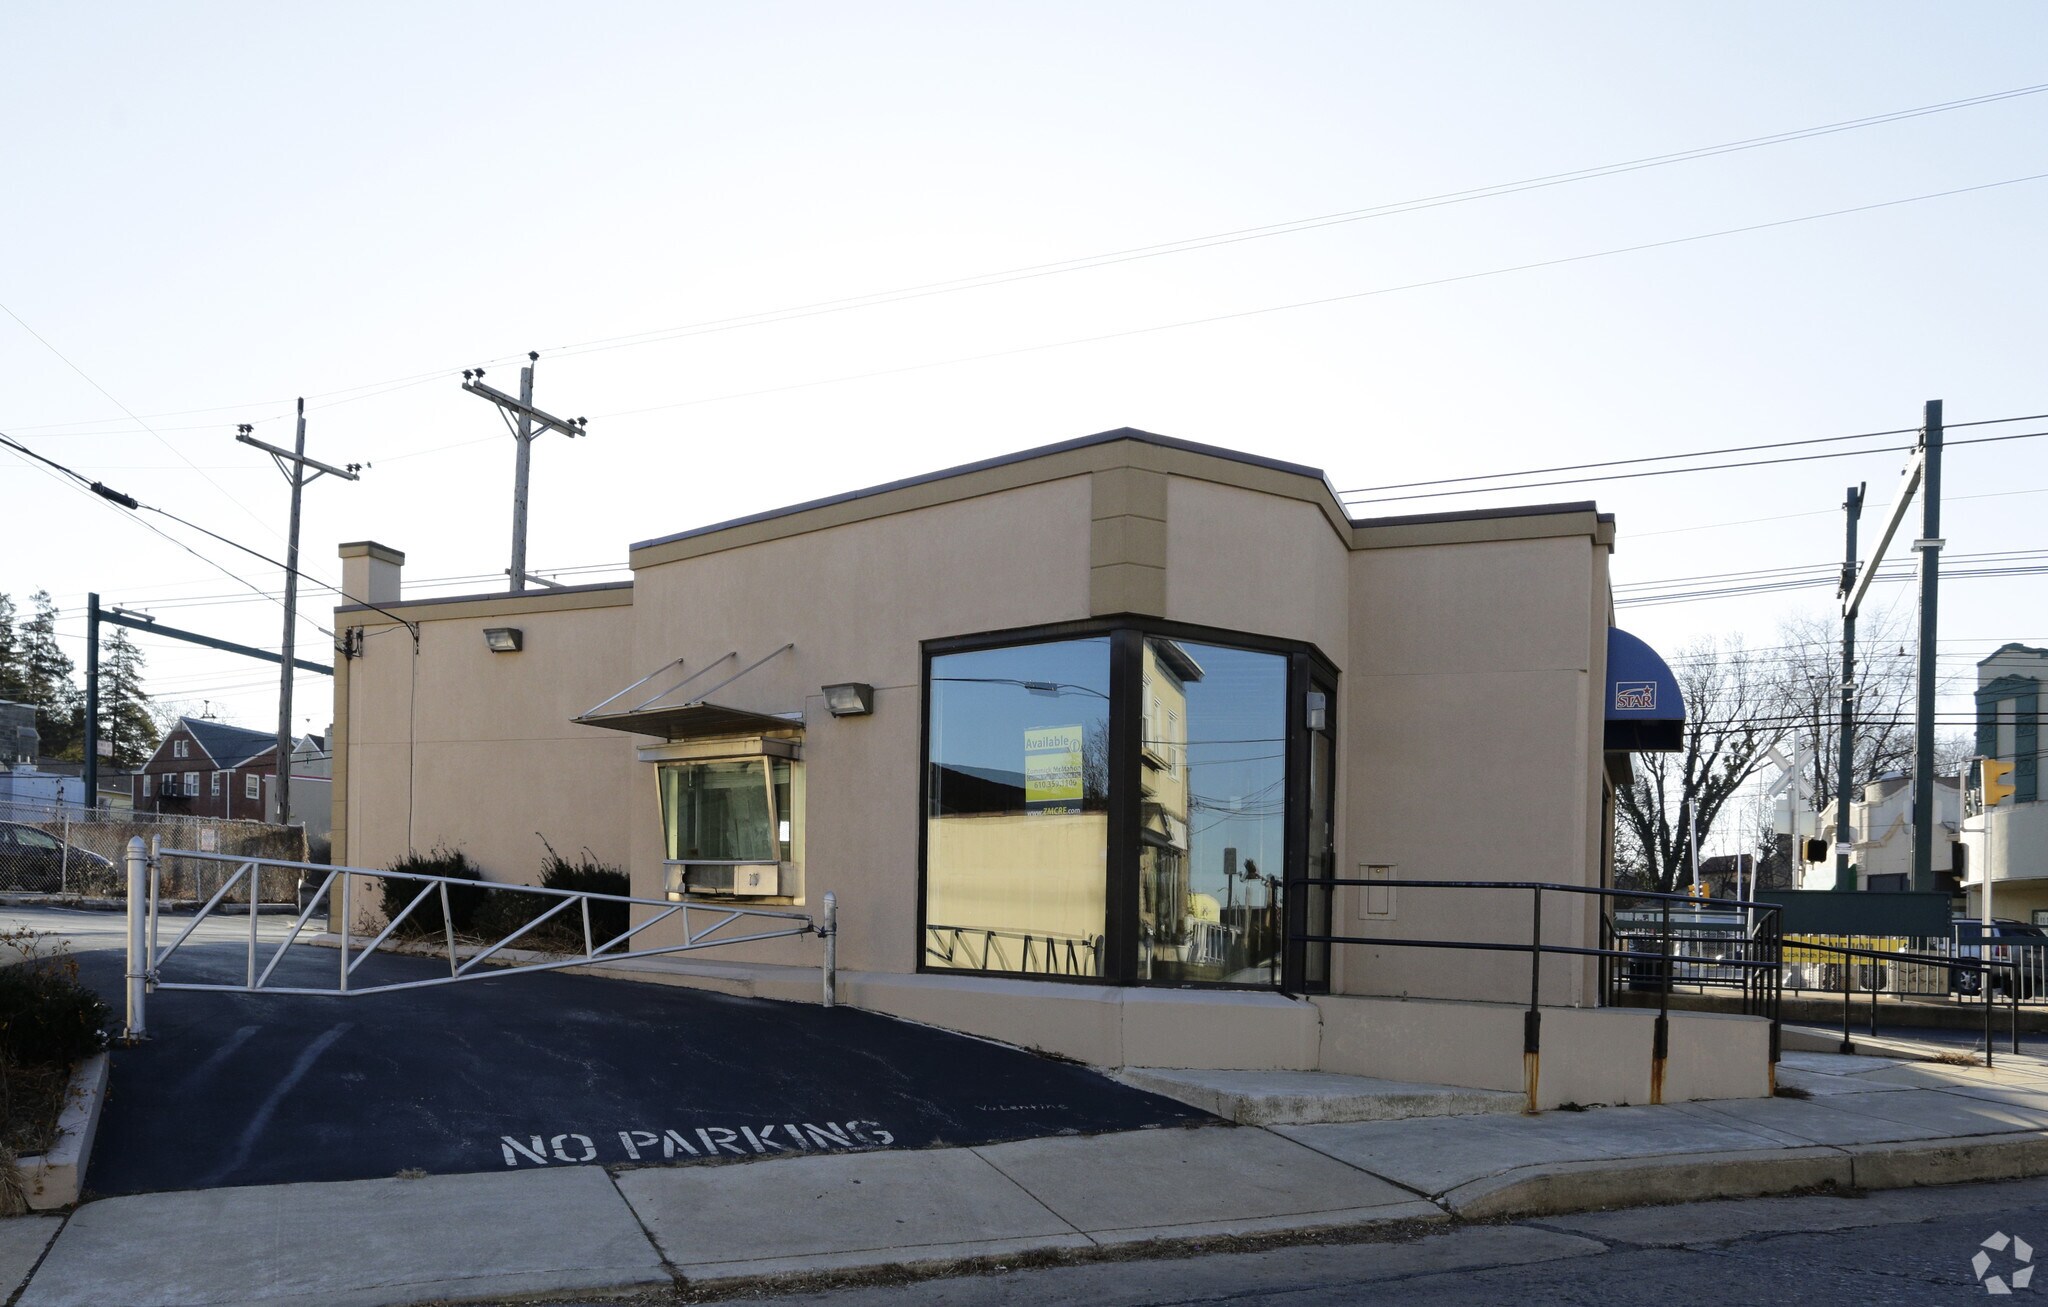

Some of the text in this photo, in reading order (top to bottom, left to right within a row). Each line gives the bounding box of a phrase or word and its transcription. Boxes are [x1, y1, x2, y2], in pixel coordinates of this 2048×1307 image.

[1617, 695, 1654, 707] STAR
[1026, 735, 1069, 749] Available
[1053, 765, 1081, 773] McMahon
[500, 1120, 895, 1166] NO PARKING
